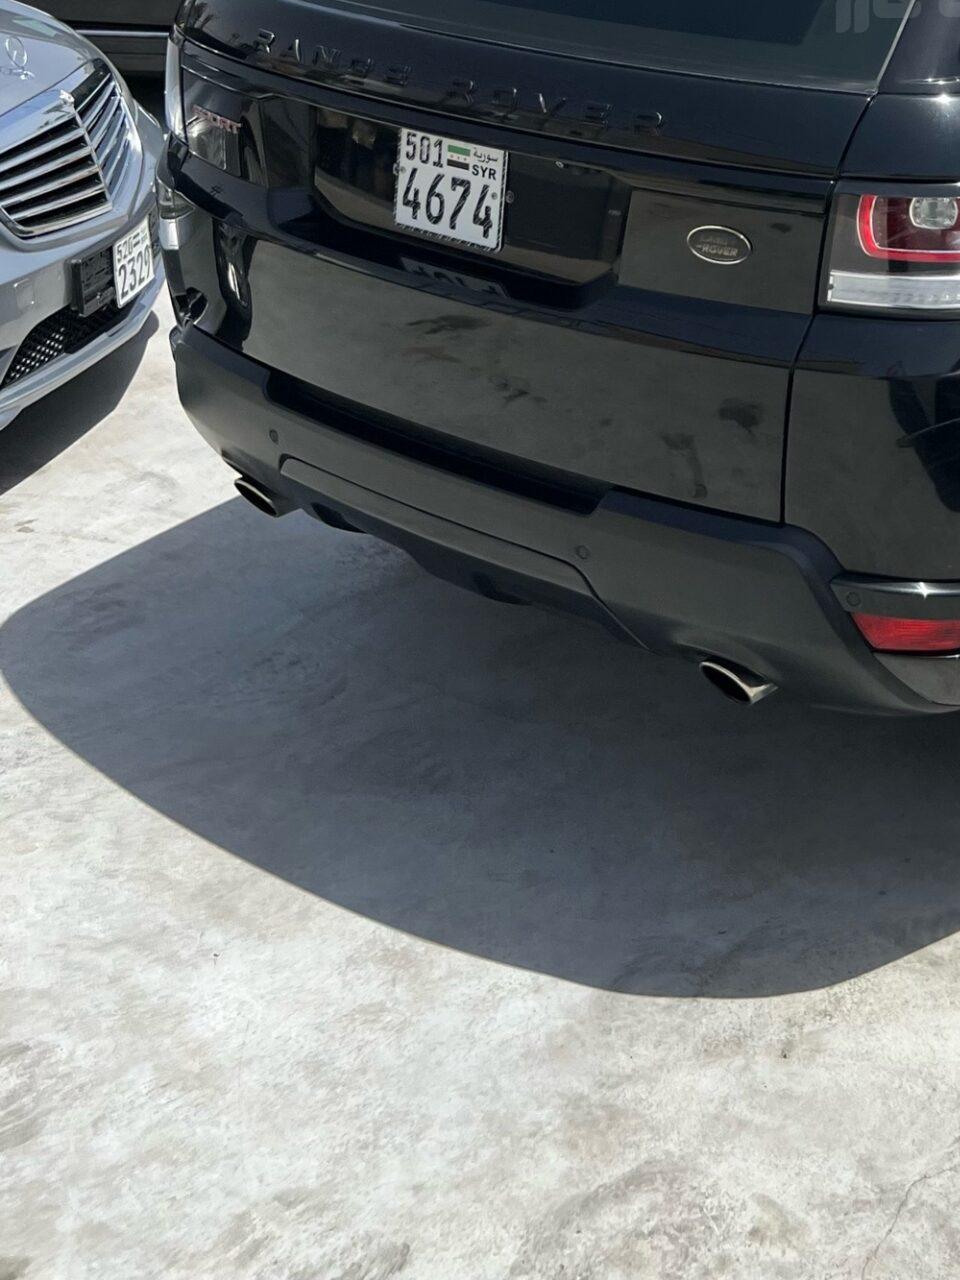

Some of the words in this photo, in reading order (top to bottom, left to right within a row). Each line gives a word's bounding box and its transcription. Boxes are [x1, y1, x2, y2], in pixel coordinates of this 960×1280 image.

[253, 28, 414, 86] RANGE
[444, 77, 667, 136] ROVER
[192, 104, 242, 134] SPORT
[406, 132, 443, 168] 501
[473, 147, 498, 164] سورية
[472, 164, 497, 180] SYR
[402, 167, 493, 239] 4674
[702, 243, 738, 256] ROVER
[118, 244, 151, 299] 2329
